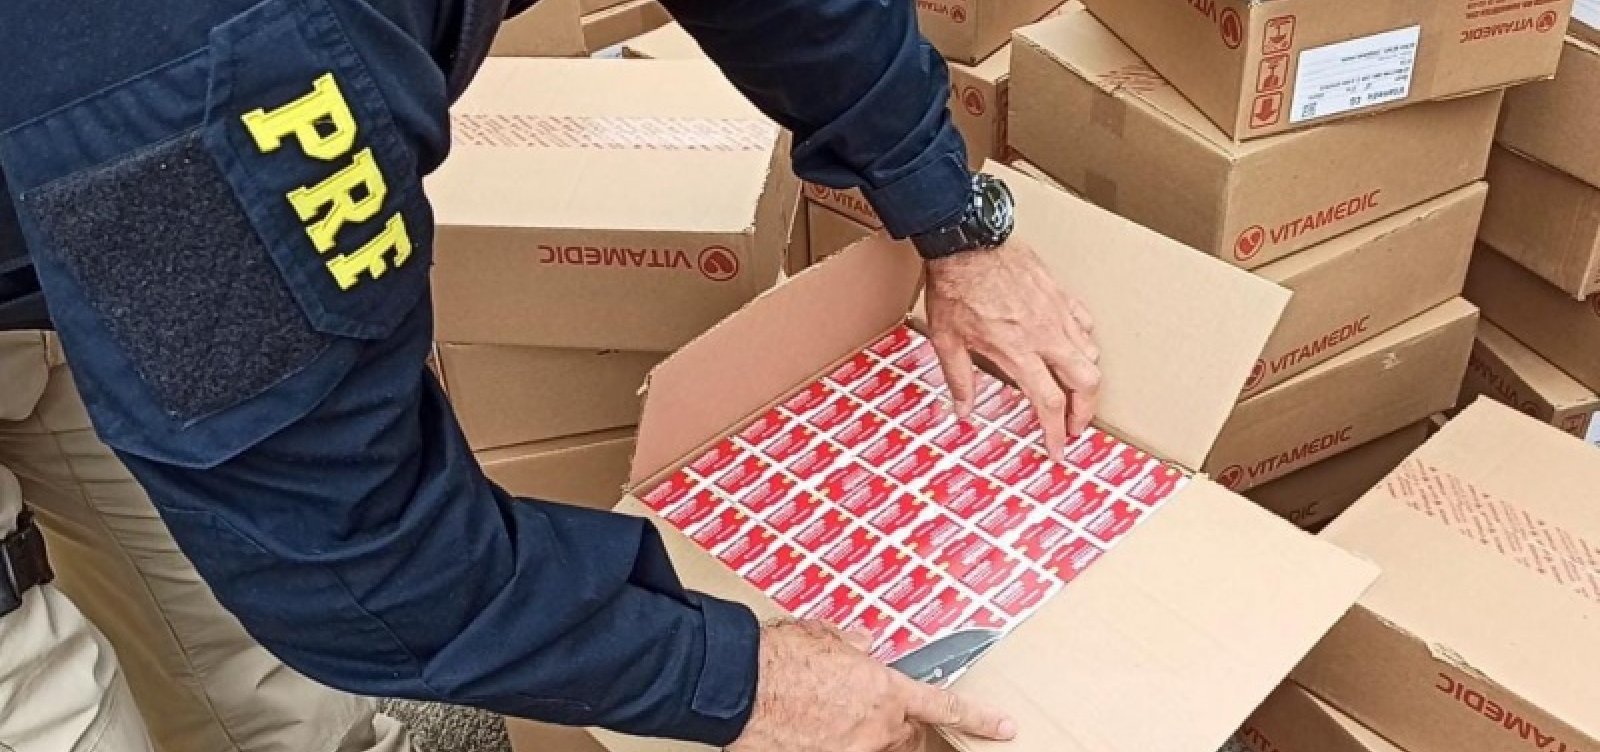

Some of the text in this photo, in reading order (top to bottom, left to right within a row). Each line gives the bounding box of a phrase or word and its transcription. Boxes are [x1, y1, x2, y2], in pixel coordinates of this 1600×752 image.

[1459, 18, 1533, 43] VITAMEDIC
[240, 72, 413, 291] PRF
[1269, 188, 1381, 245] VITAMEDIC
[537, 244, 693, 270] VITAMEDIC
[1269, 314, 1371, 374] VITAMEDIC
[1247, 424, 1353, 478] VITAMEDIC
